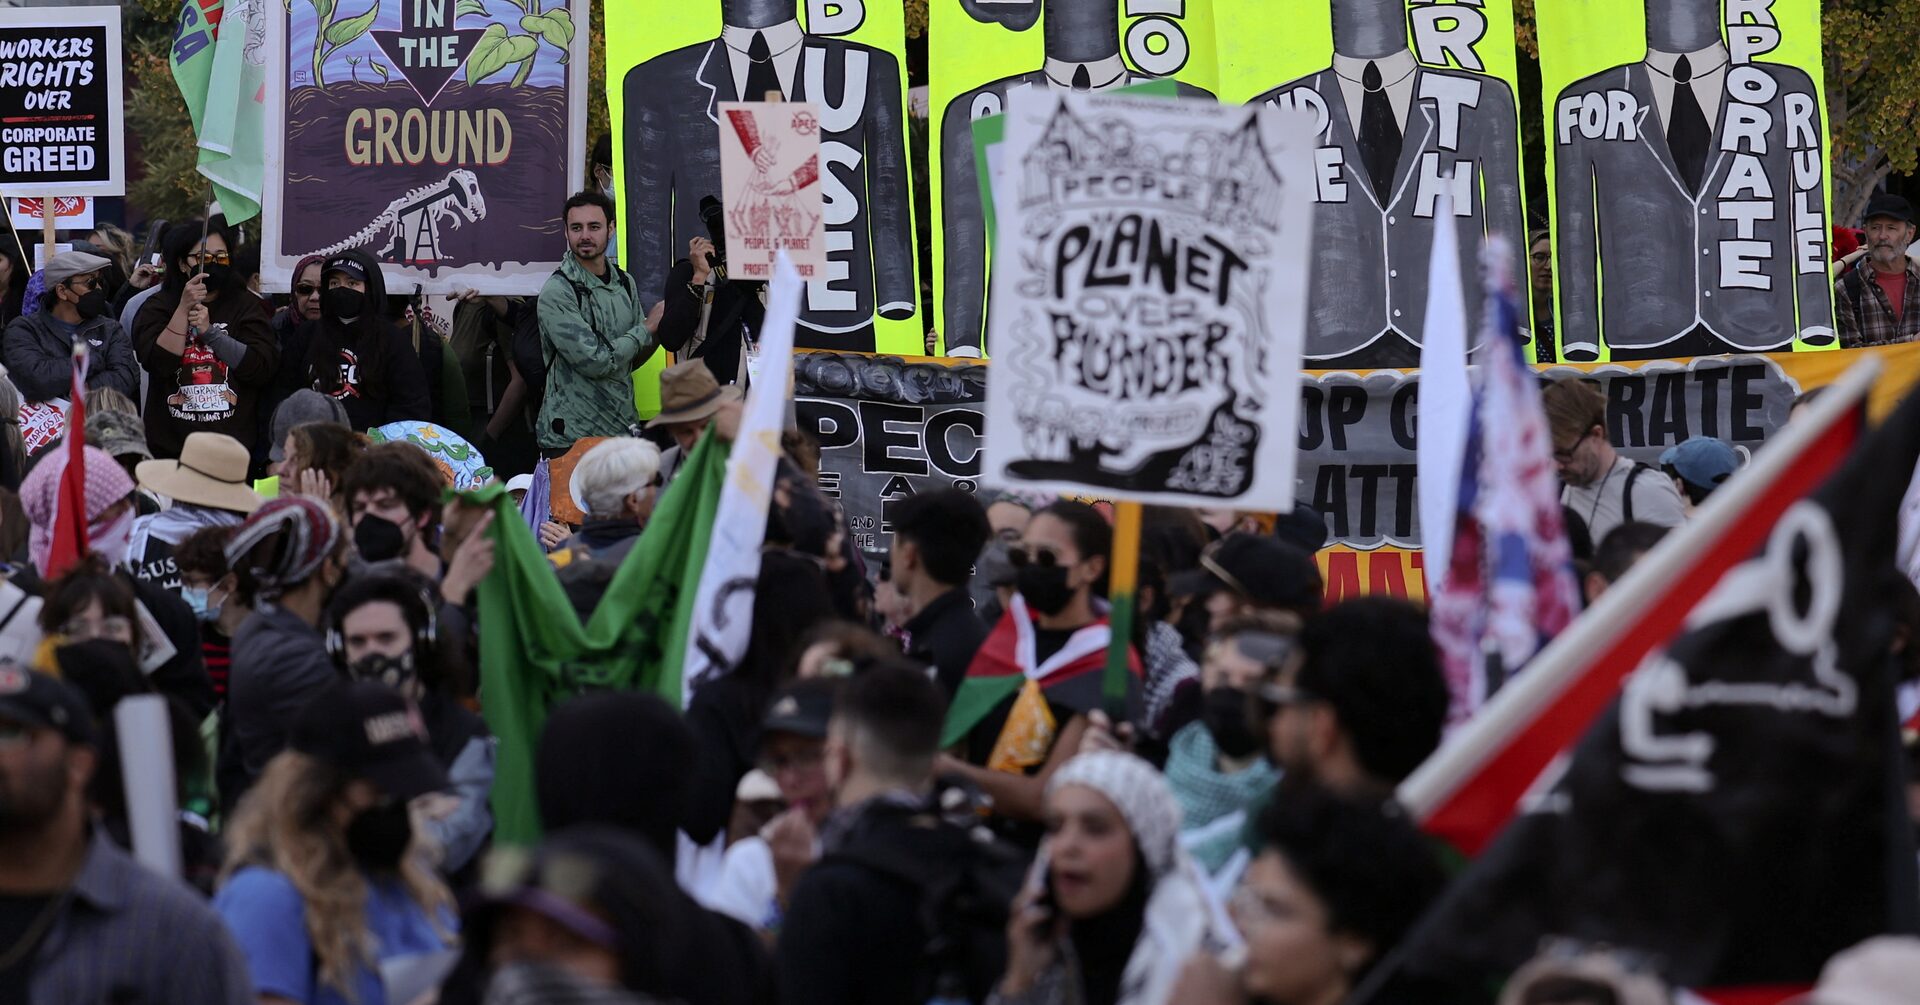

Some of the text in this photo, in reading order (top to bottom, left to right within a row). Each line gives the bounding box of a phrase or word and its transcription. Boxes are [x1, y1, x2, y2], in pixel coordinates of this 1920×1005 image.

[414, 0, 445, 28] IN
[0, 37, 94, 60] WORKERS
[398, 35, 460, 68] THE
[0, 60, 94, 89] RIGHTS
[24, 90, 72, 111] OVER
[791, 118, 817, 129] APEC
[1557, 89, 1640, 145] FOR
[2, 126, 96, 144] CORPORATE
[344, 107, 513, 167] GROUND
[3, 145, 95, 173] GREED
[1783, 92, 1826, 275] RULE
[744, 237, 770, 250] PEOPLE
[1055, 213, 1248, 304] PLANET
[1075, 294, 1197, 327] OVER
[1050, 311, 1230, 401] PLUNDER
[26, 418, 55, 448] MARCOS
[851, 516, 875, 530] AND
